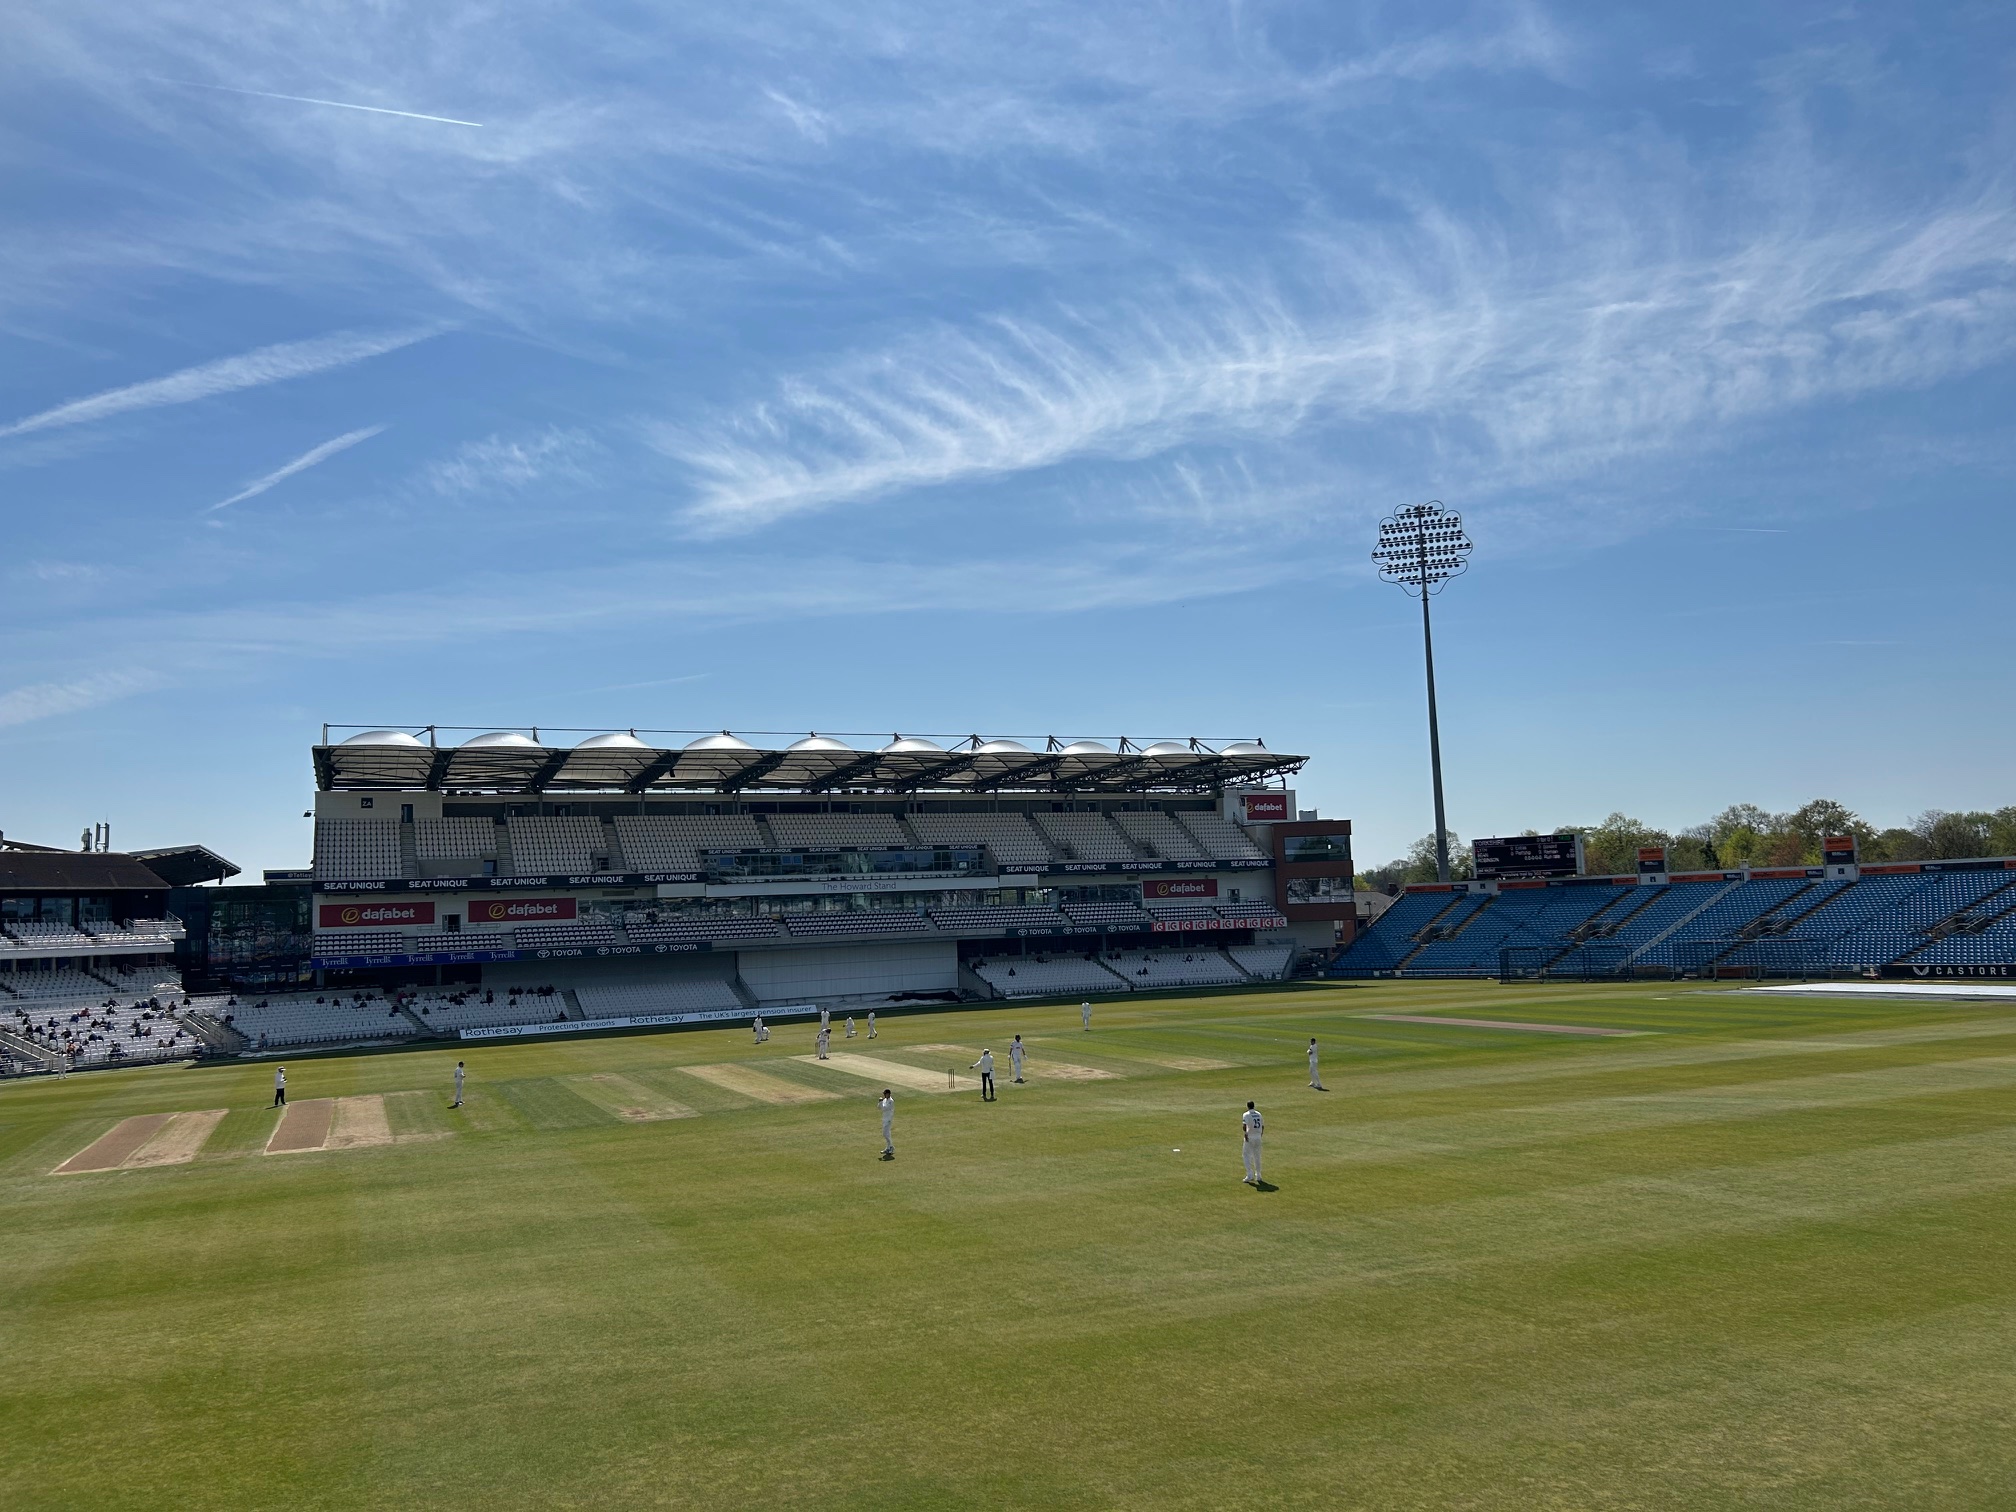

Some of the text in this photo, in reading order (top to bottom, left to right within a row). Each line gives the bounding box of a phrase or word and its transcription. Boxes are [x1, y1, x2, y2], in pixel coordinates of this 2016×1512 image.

[1254, 803, 1282, 812] dafabet
[433, 880, 468, 888] UNIQUE
[514, 878, 547, 886] UNIQUE
[840, 882, 872, 890] Howard
[1170, 883, 1205, 894] dafabet
[362, 908, 415, 921] dafabet
[508, 904, 557, 916] dafabet
[1936, 967, 2007, 975] CASTORE
[730, 1010, 756, 1018] largest
[629, 1014, 684, 1024] Rothesay
[539, 1020, 615, 1031] Protecting Pensions
[466, 1026, 523, 1036] Rothesay
[1253, 1119, 1260, 1128] 25
